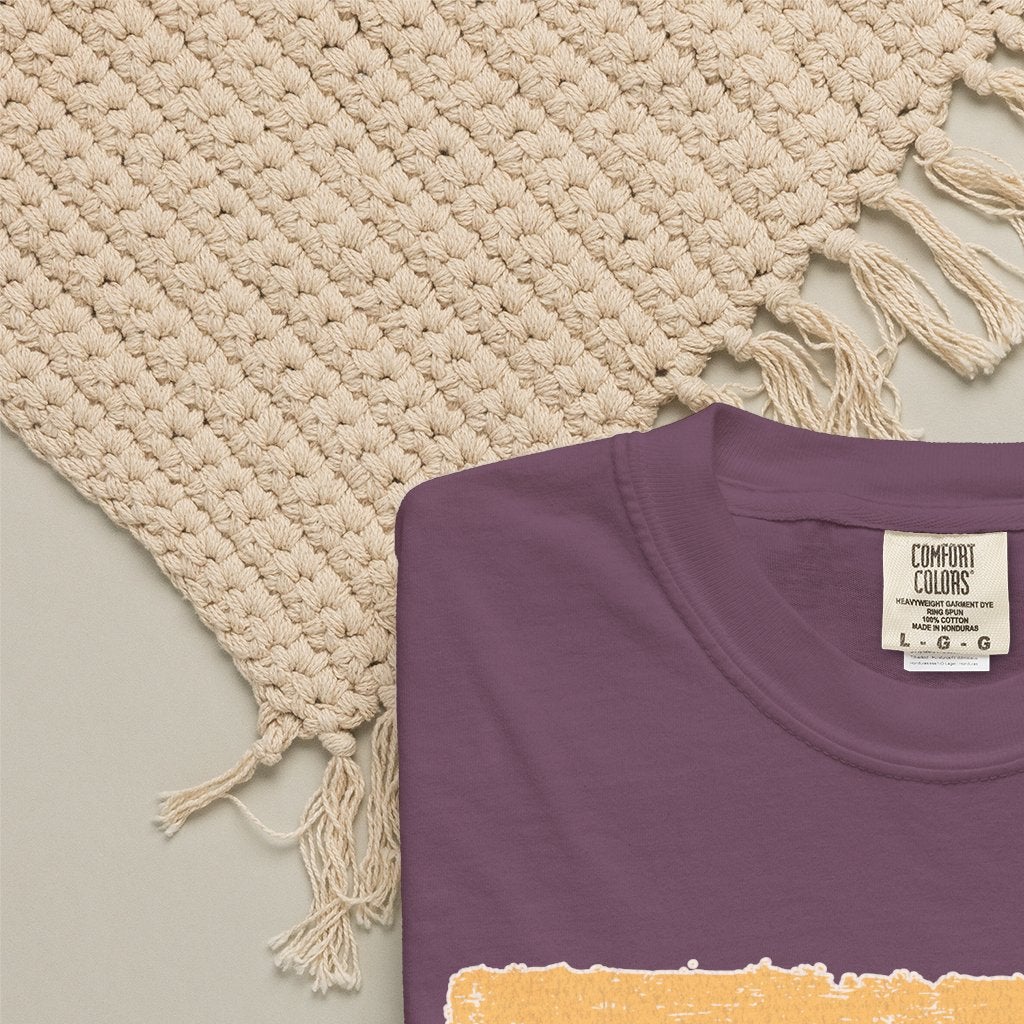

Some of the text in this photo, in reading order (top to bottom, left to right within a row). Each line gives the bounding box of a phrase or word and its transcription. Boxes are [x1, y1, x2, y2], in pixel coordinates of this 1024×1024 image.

[911, 543, 975, 569] COMFORT
[895, 598, 944, 608] HEAVYWEIGHT
[946, 601, 979, 609] GARMENT
[927, 608, 943, 616] RING
[922, 616, 939, 624] 100%
[912, 623, 931, 632] MADE
[900, 632, 910, 647] L
[937, 635, 950, 650] G
[977, 635, 991, 650] G
